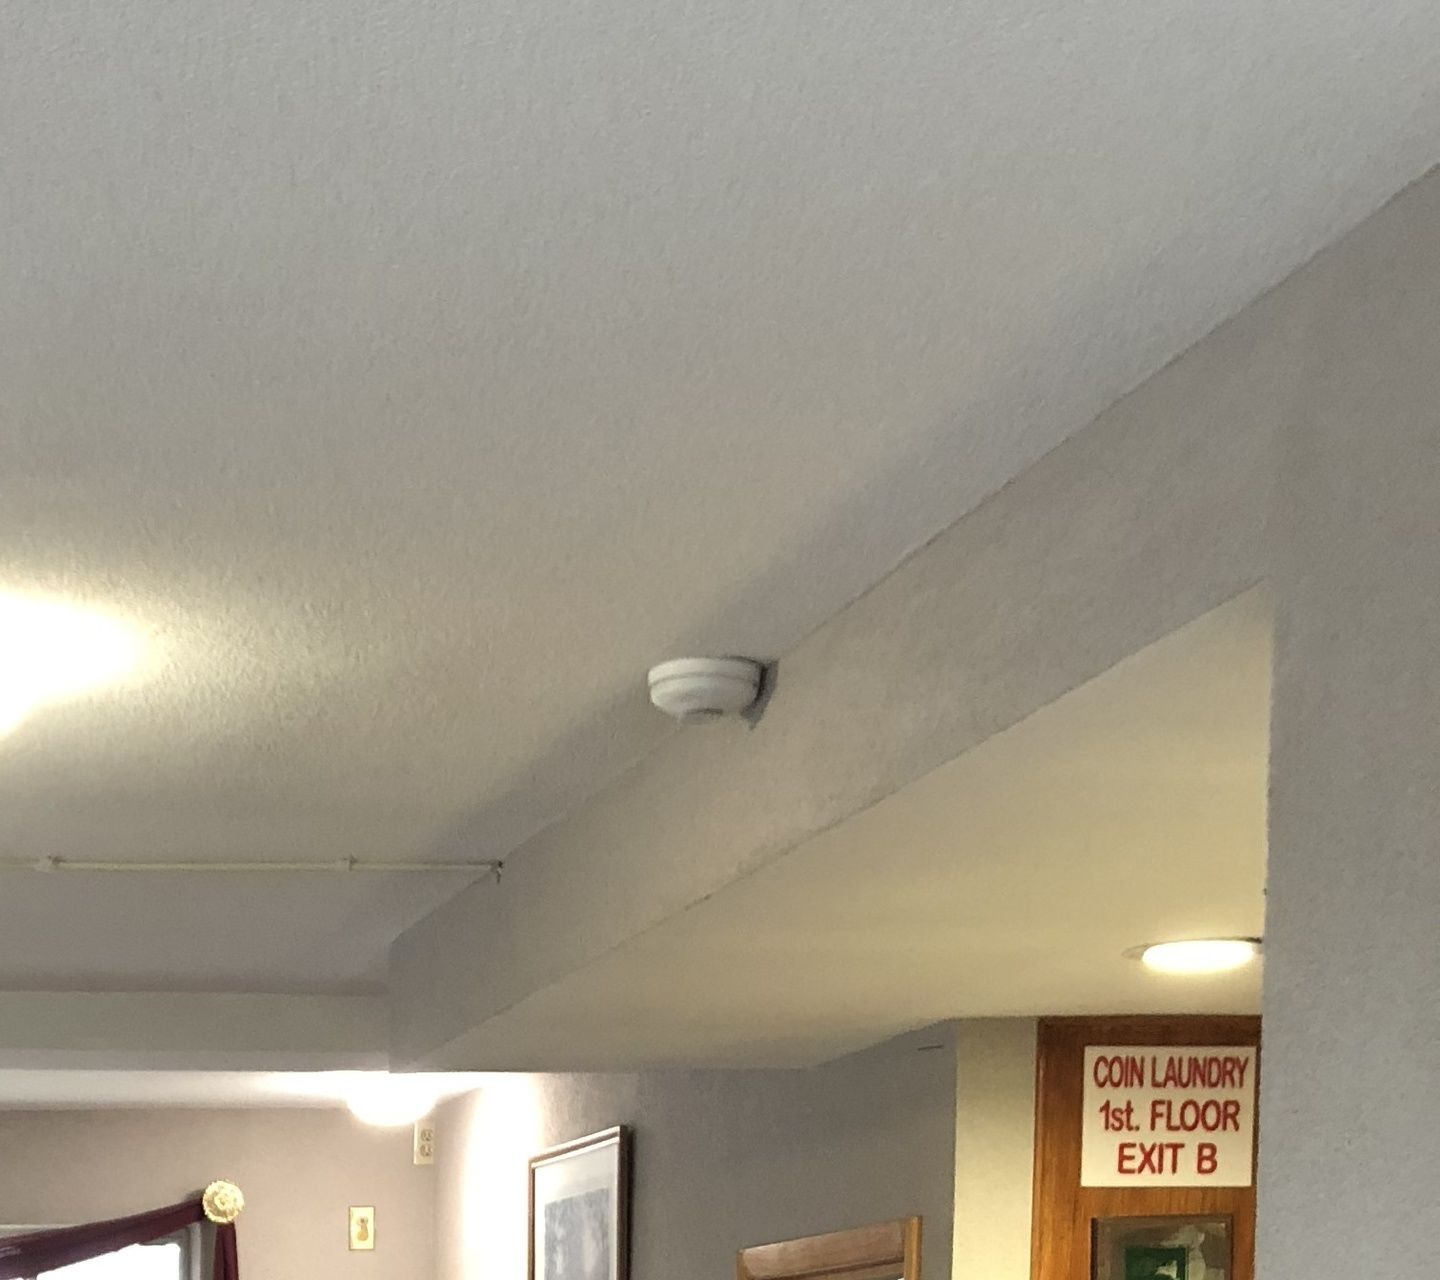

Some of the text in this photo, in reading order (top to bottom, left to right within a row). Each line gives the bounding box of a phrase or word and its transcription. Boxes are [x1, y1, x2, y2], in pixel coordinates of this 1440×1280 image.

[1093, 1055, 1249, 1088] COIN LAUNDRY
[1099, 1099, 1241, 1131] 1st. FLOOR
[1117, 1142, 1218, 1174] EXIT B
